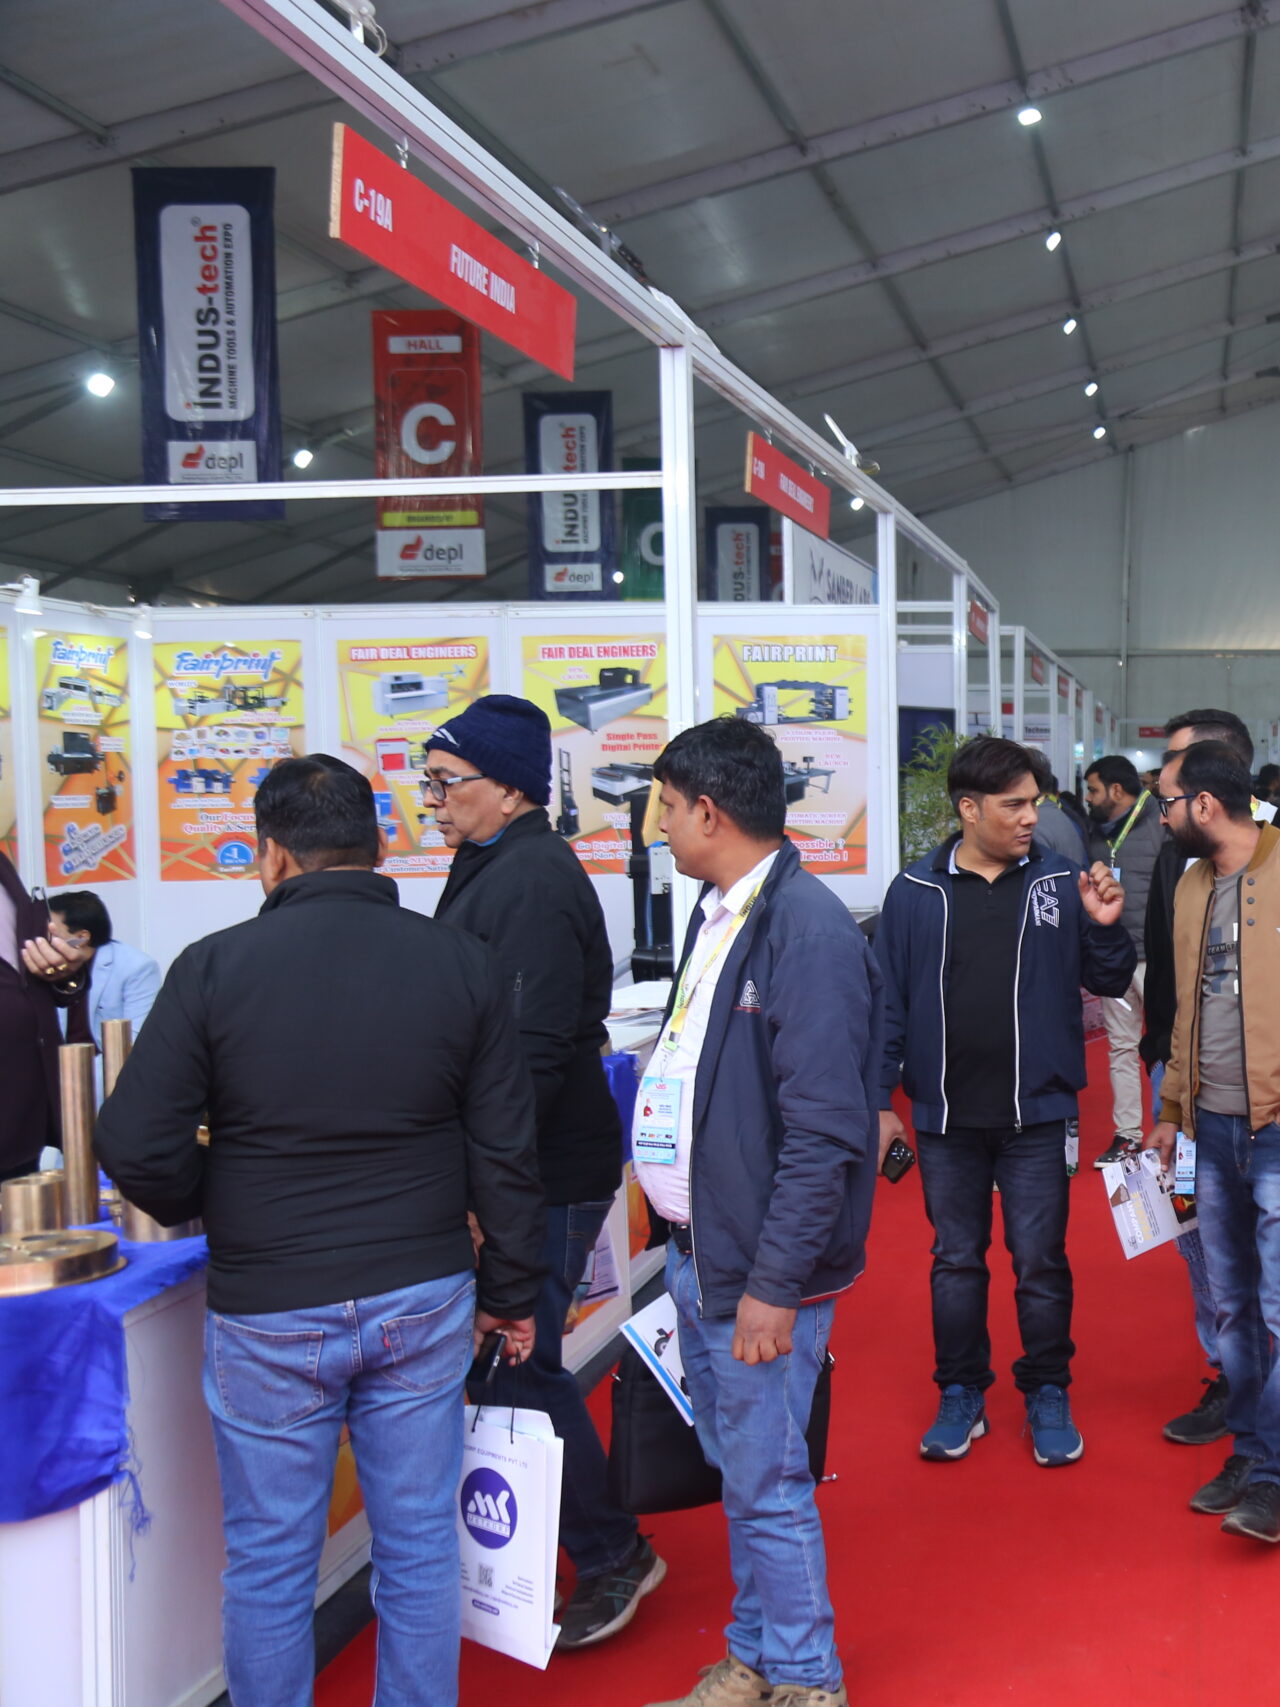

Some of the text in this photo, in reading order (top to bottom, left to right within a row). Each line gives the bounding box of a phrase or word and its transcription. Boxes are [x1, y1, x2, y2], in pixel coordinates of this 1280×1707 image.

[353, 178, 393, 232] C-19A
[222, 223, 234, 249] EXPO
[223, 252, 235, 316] AUTOMATION
[225, 330, 237, 361] TOOLS
[406, 339, 443, 351] HALL
[401, 402, 456, 465] C
[423, 543, 463, 564] depl
[352, 645, 477, 660] FAIR DEAL ENGINEERS
[542, 645, 656, 659] FAIR DEAL ENGINEERS
[743, 645, 838, 662] FAIRPRINT
[636, 732, 658, 740] Pass
[602, 743, 631, 752] Digital
